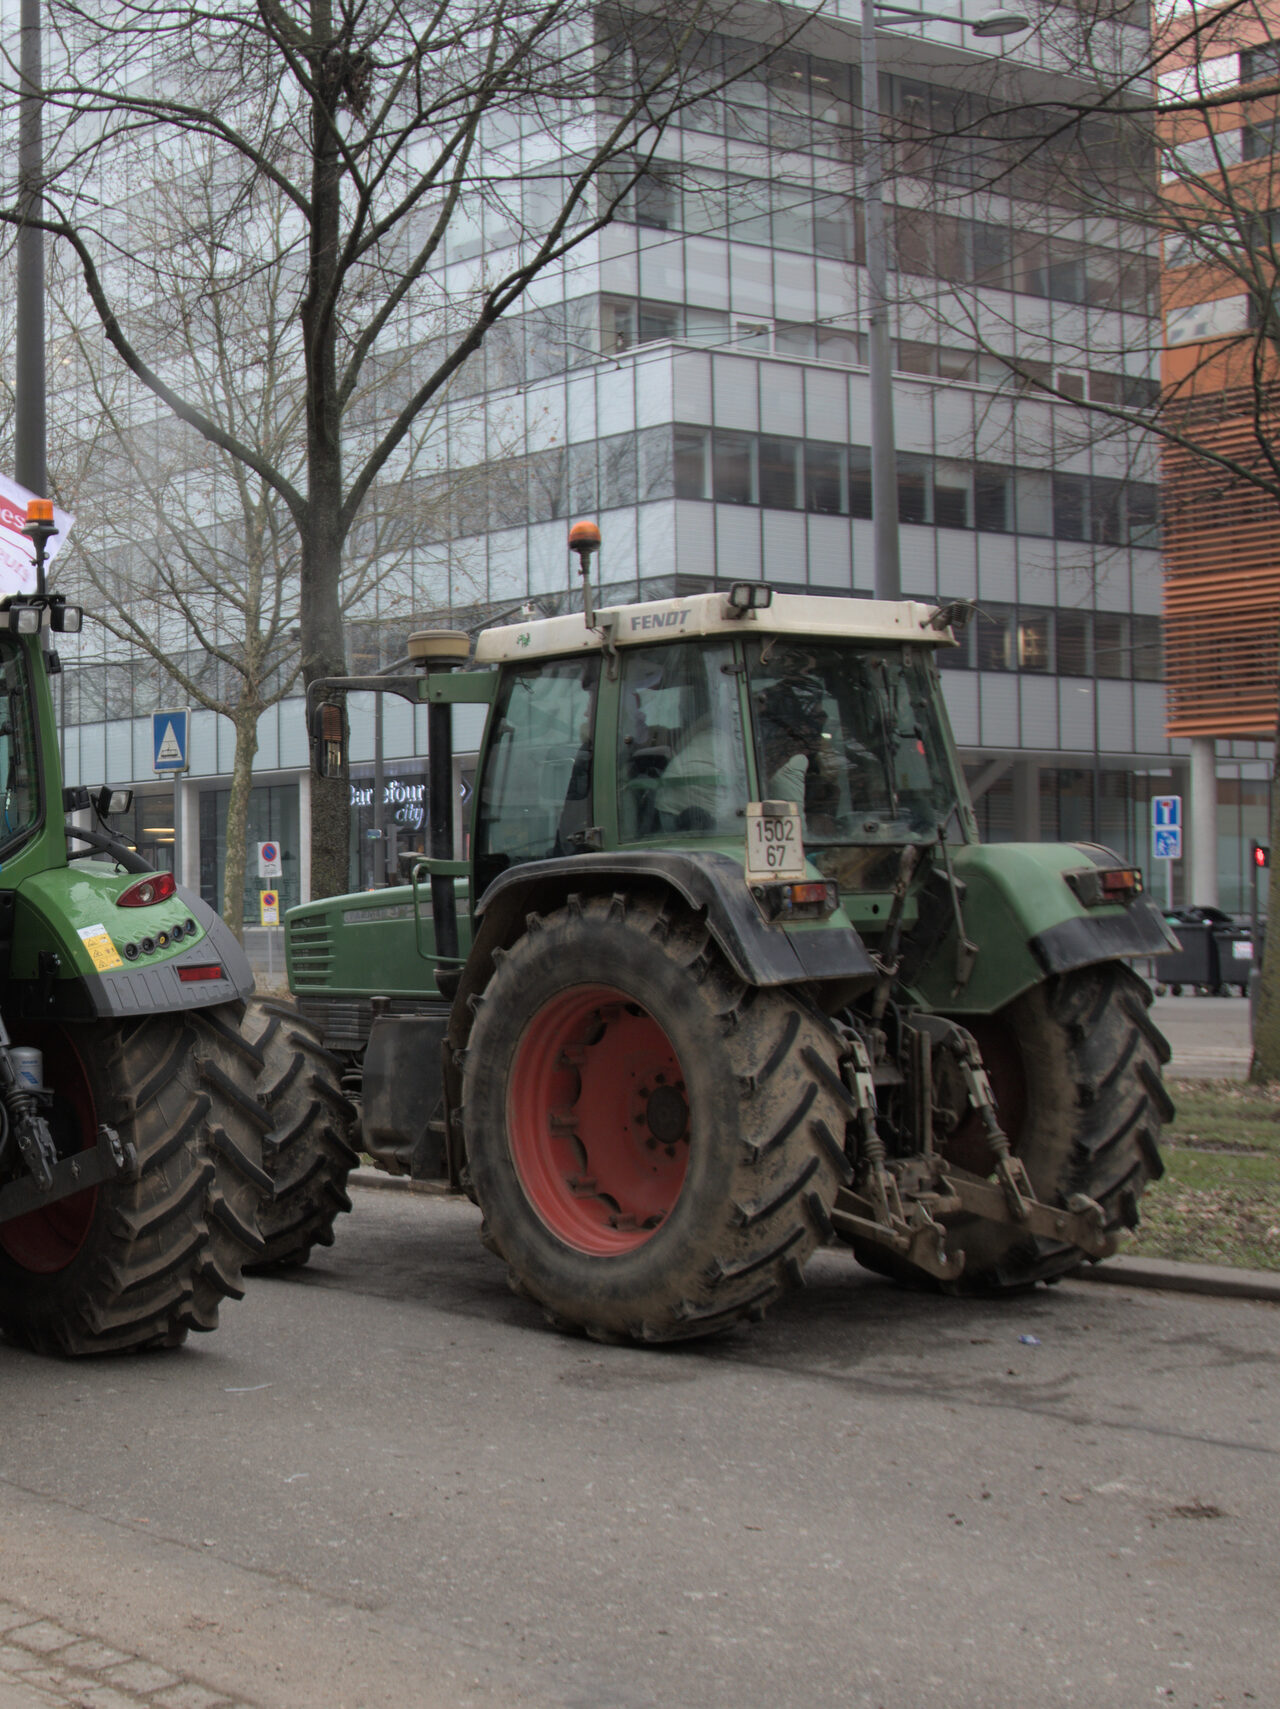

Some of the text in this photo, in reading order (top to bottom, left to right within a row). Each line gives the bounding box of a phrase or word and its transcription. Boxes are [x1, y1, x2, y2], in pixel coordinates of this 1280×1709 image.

[630, 608, 692, 631] FENDT
[395, 803, 424, 830] city
[756, 820, 794, 842] 1502
[766, 845, 786, 867] 67
